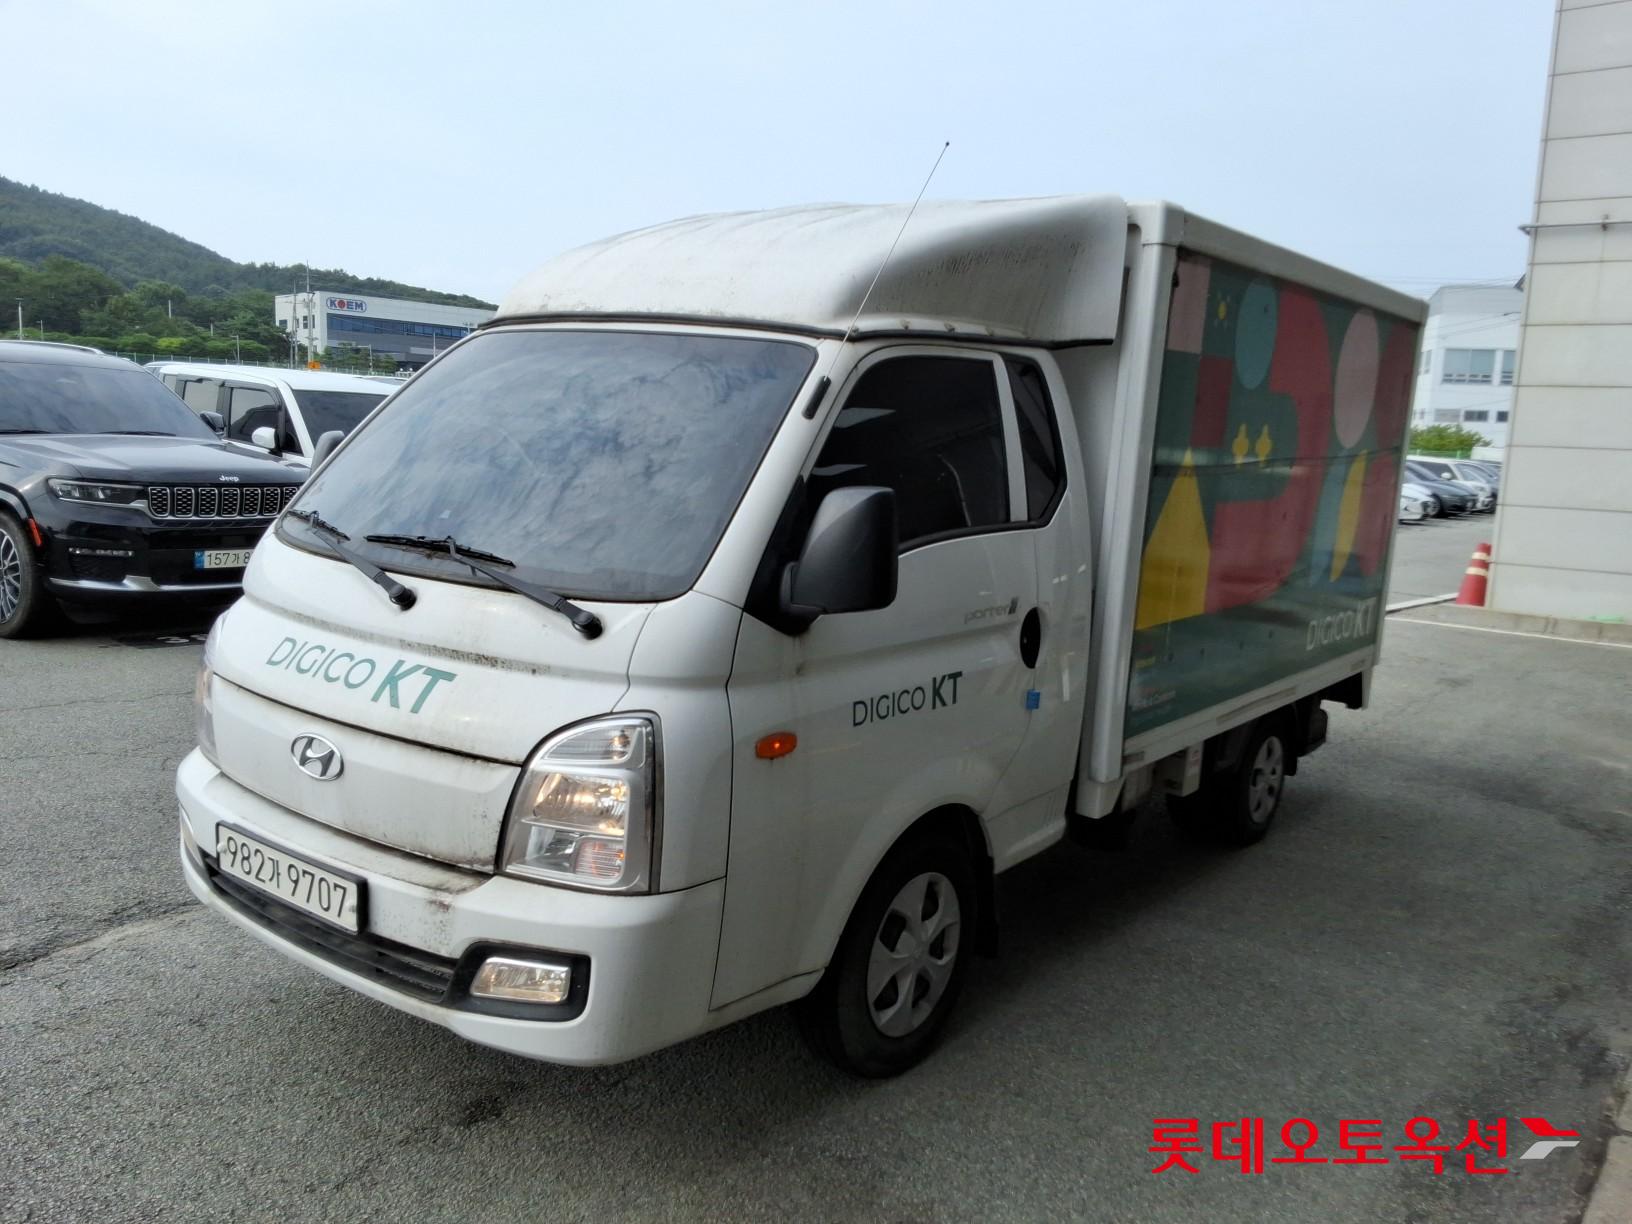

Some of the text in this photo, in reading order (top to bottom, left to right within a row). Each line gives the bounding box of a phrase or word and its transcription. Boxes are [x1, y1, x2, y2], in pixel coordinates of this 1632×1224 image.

[266, 636, 458, 715] DIGICO KT
[852, 671, 963, 728] DIGICO KT
